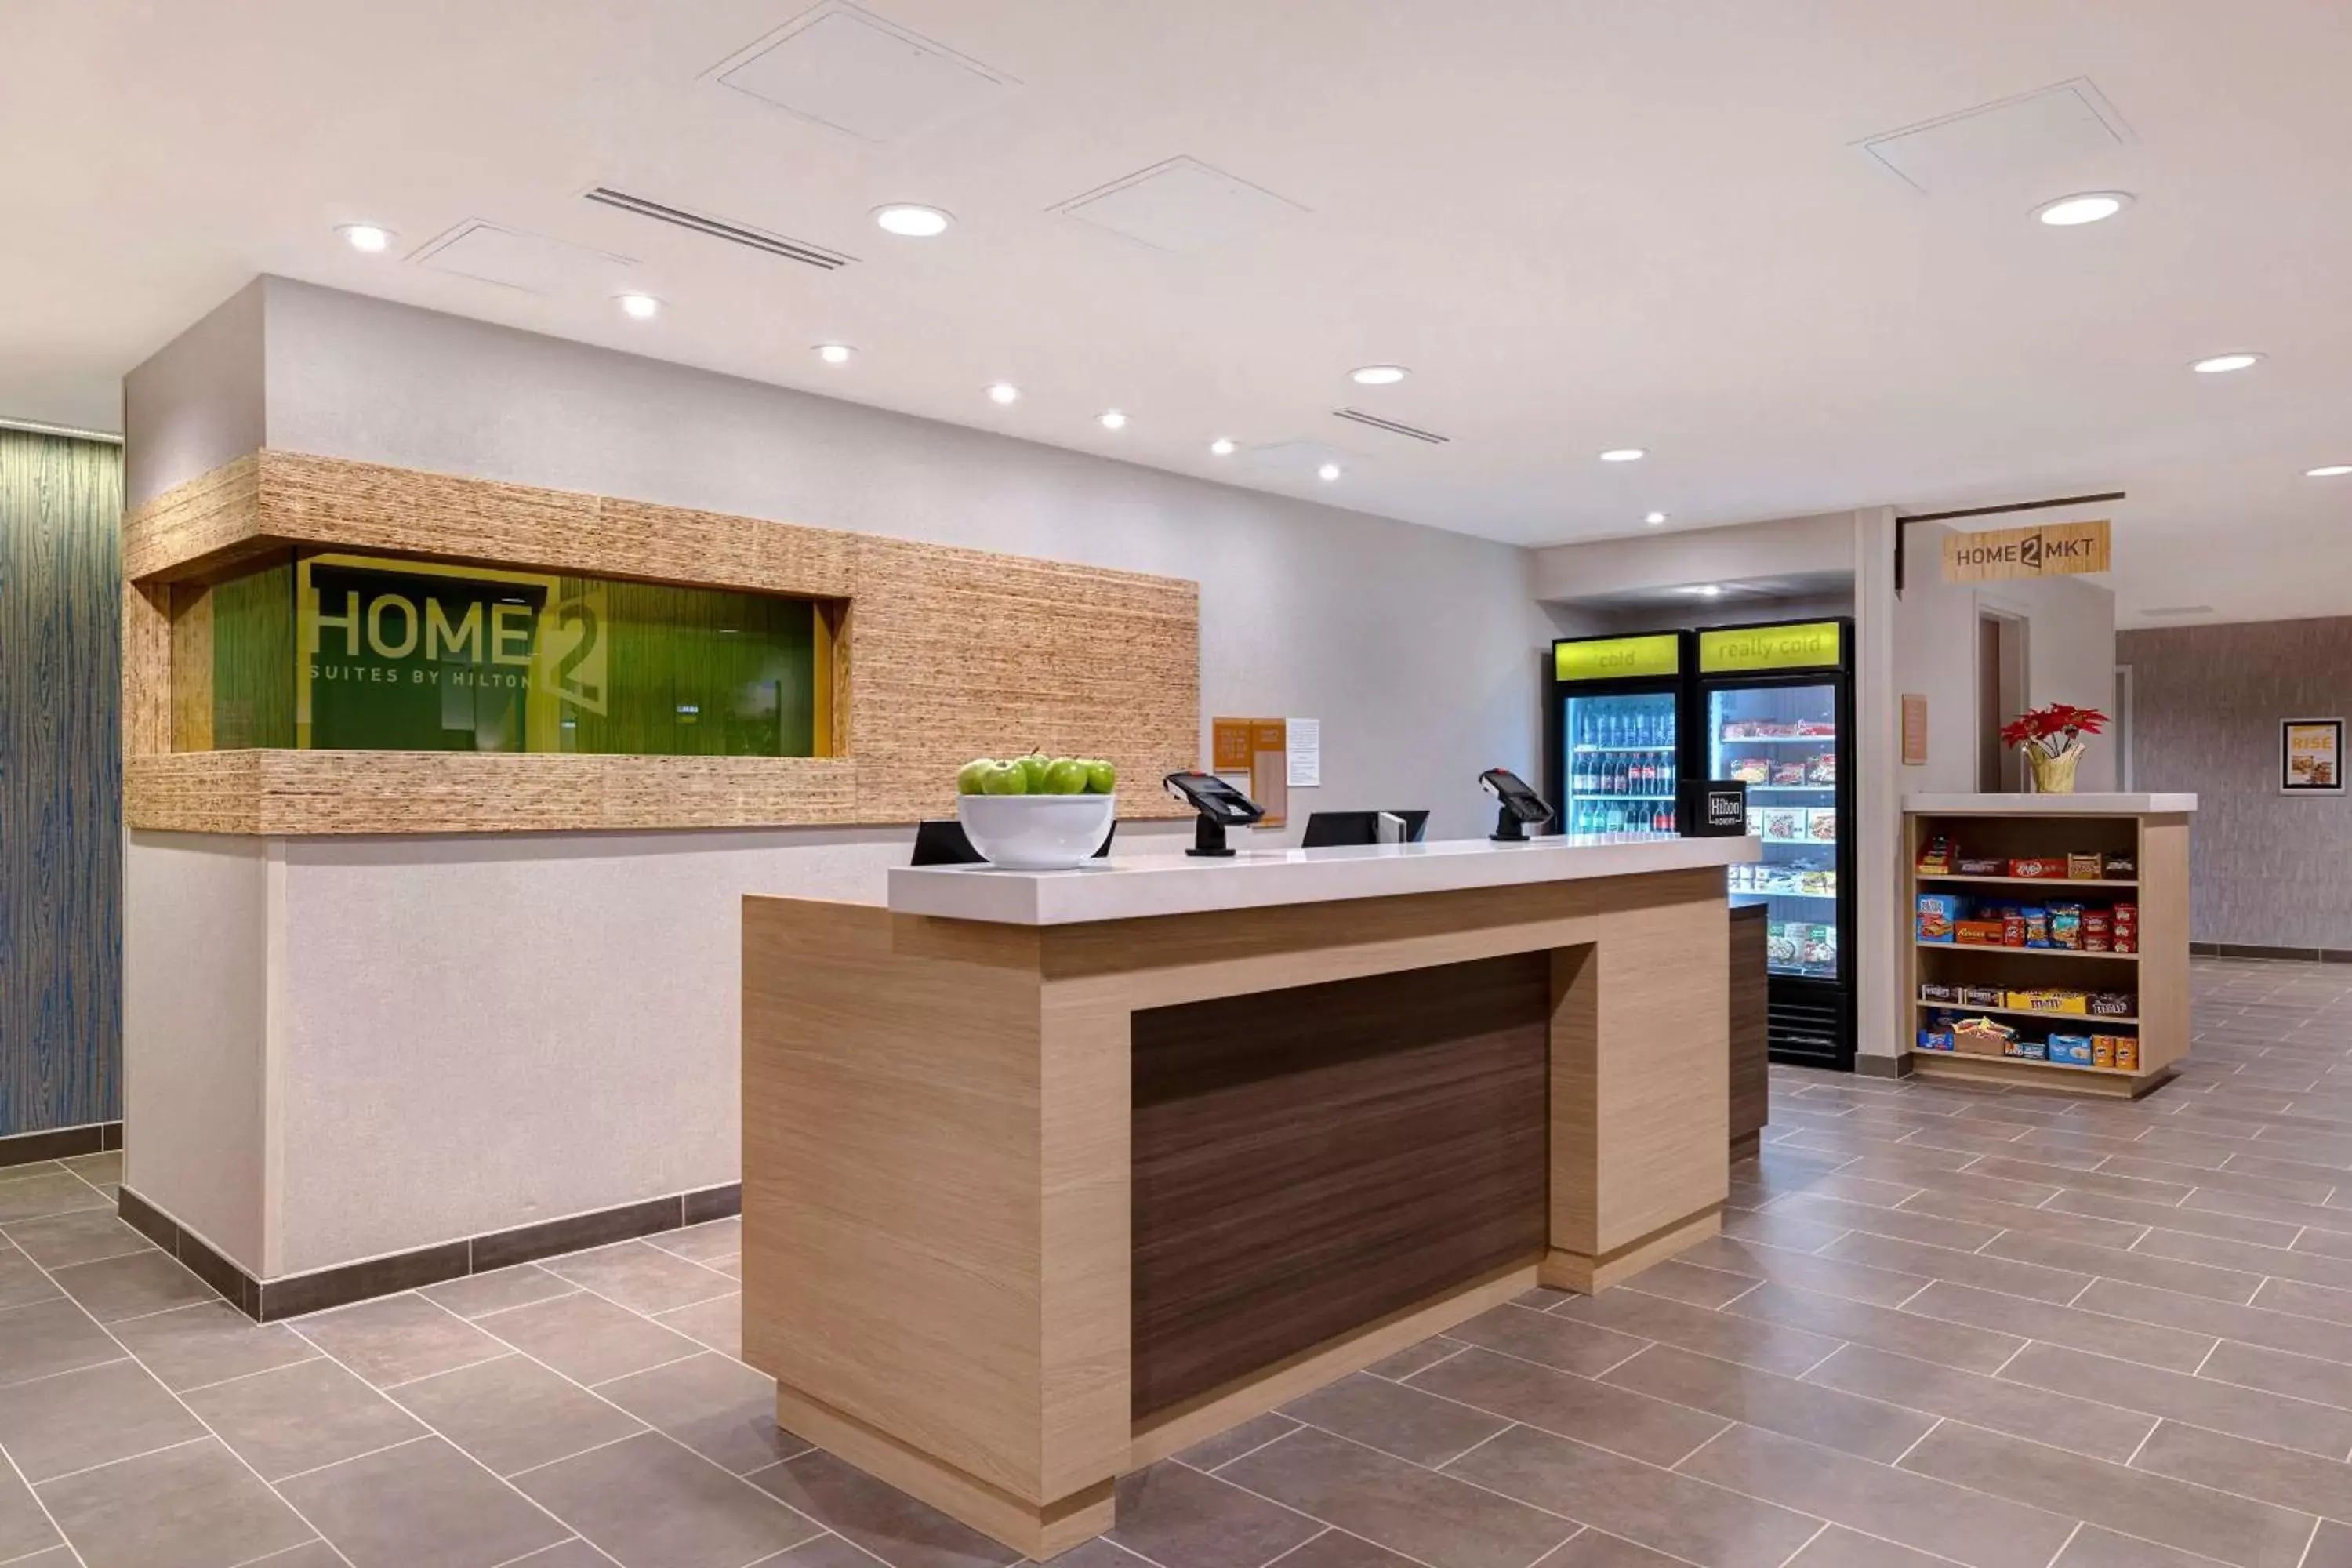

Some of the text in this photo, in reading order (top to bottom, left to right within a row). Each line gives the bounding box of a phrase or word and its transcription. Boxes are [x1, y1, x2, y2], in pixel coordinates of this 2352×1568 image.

[1958, 544, 2017, 565] HOME
[2045, 539, 2094, 558] MKT
[309, 588, 532, 665] HOME
[1599, 649, 1635, 667] cold
[1719, 633, 1820, 659] really cold
[310, 665, 532, 690] SUITES BY HILTON
[2293, 737, 2332, 750] RISE
[1711, 797, 1740, 815] Hilton
